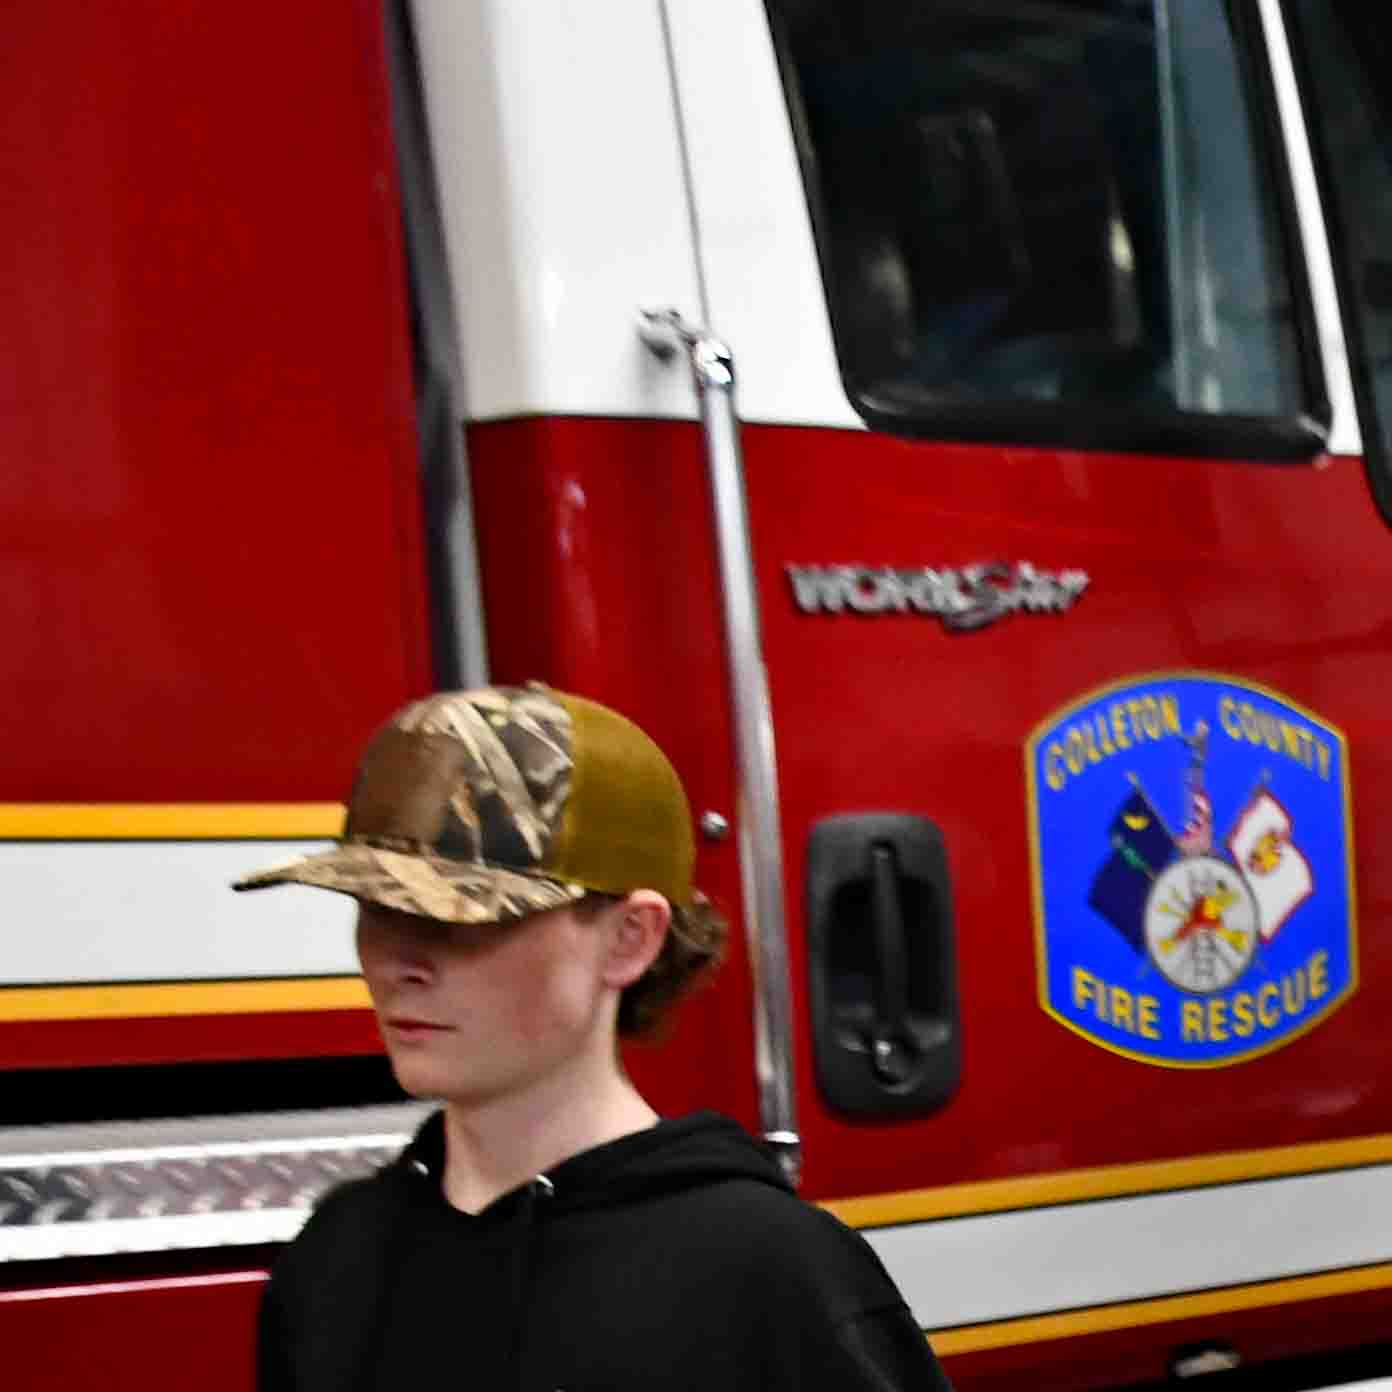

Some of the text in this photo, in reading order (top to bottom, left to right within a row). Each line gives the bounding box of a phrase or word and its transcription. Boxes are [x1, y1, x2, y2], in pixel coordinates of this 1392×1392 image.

[1044, 694, 1330, 791] COLLETON COUNTY
[1072, 950, 1329, 1041] FIRE RESCUE
